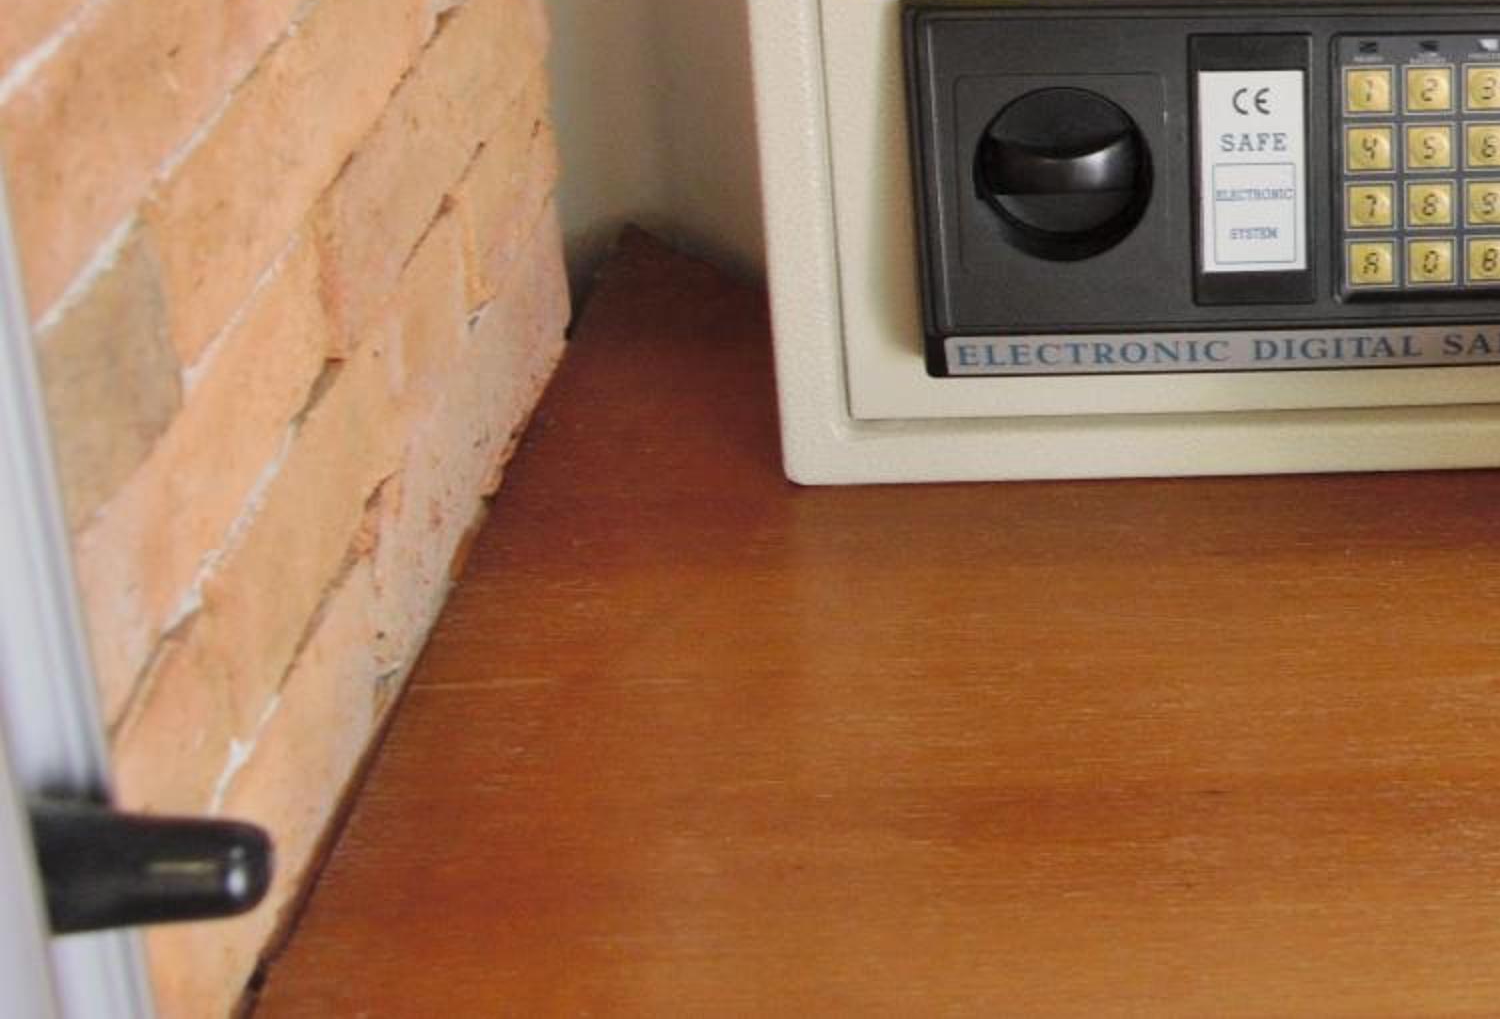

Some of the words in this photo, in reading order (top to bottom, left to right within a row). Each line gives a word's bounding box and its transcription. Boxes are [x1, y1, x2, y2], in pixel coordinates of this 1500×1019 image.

[1232, 87, 1271, 115] CE
[1421, 78, 1438, 102] 2
[1481, 77, 1497, 100] 3
[1220, 133, 1288, 152] SAFE
[1362, 137, 1378, 161] 4
[1423, 136, 1437, 160] 5
[1481, 135, 1497, 158] 6
[1216, 188, 1295, 200] ELECTRONIC
[1365, 193, 1378, 217] 7
[1422, 193, 1438, 216] 8
[1230, 227, 1279, 240] SYSTEM
[957, 339, 1230, 367] ELECTRONIC
[1253, 335, 1423, 361] DIGITAL
